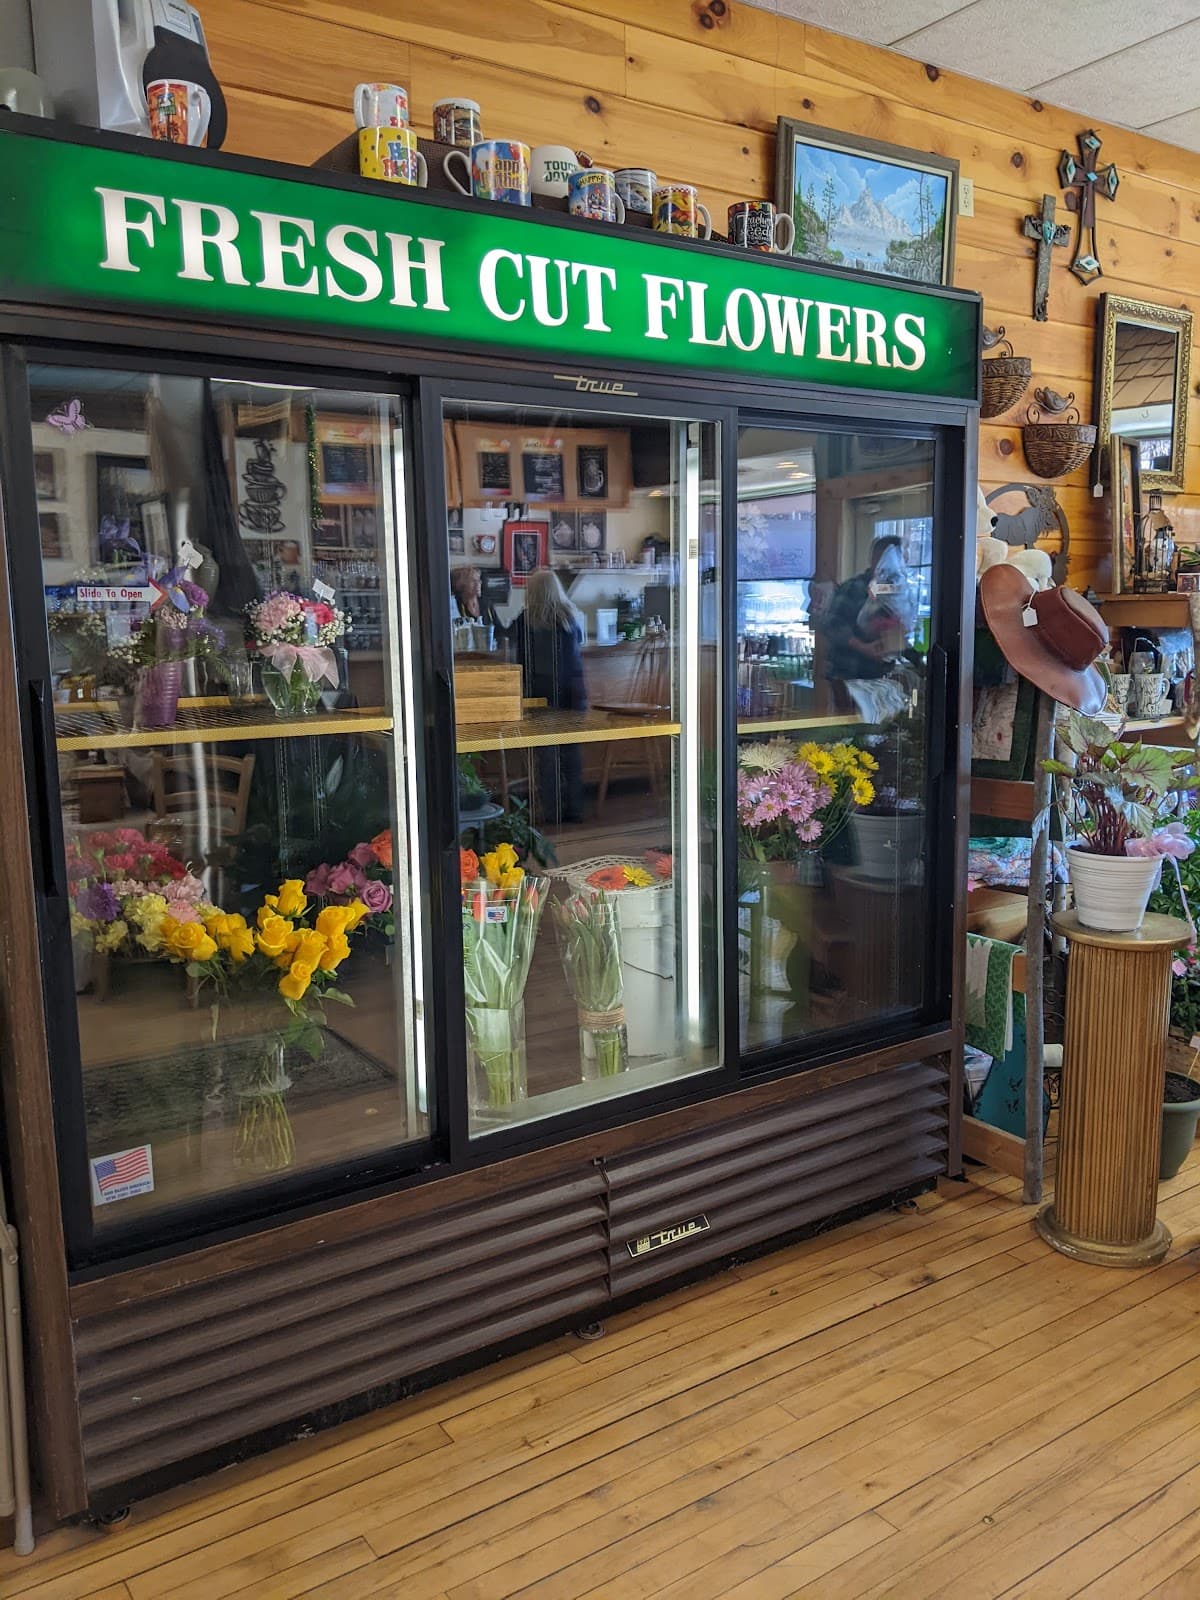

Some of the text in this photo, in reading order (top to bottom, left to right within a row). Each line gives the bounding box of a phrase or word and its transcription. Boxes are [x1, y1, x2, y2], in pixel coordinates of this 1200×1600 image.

[95, 187, 926, 371] FRESH CUT FLOWERS
[554, 375, 638, 396] true
[80, 588, 142, 600] Slide To Open
[651, 1221, 701, 1244] true
